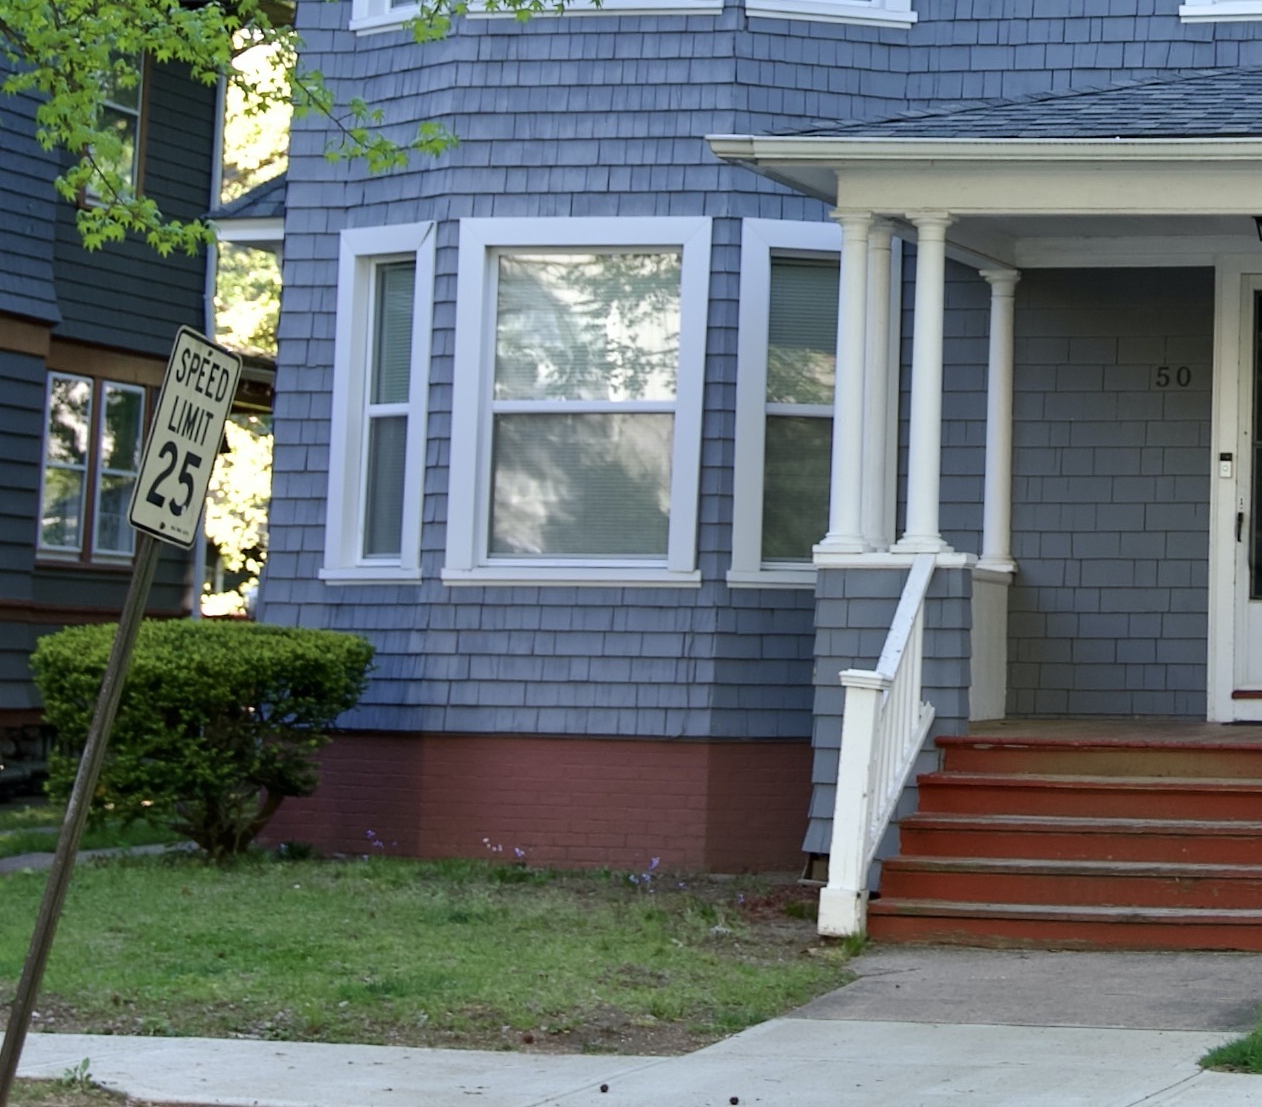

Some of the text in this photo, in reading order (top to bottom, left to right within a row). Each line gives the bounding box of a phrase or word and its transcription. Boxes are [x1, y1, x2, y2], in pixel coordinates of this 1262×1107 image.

[176, 347, 230, 403] SPEED
[1156, 366, 1191, 388] 50
[167, 395, 215, 447] LIMIT
[146, 440, 202, 517] 25
